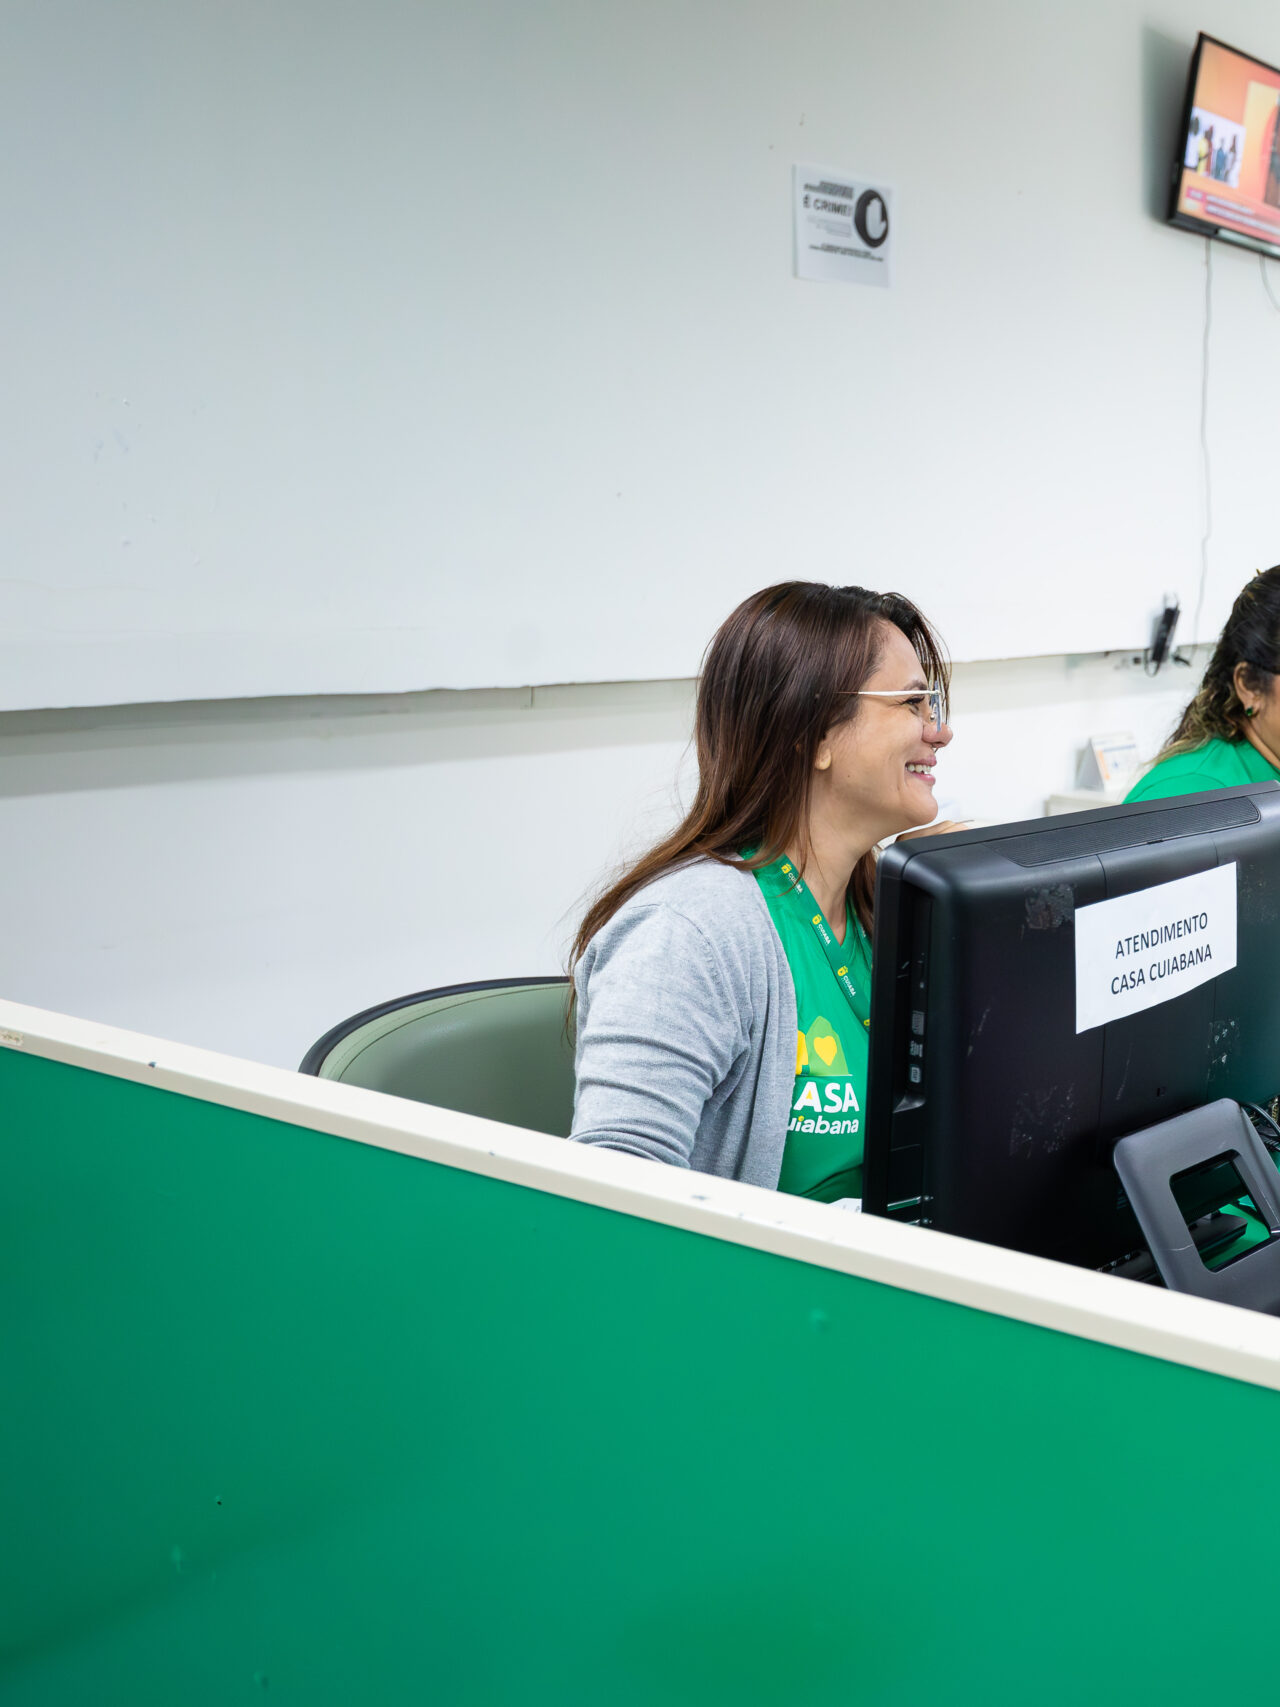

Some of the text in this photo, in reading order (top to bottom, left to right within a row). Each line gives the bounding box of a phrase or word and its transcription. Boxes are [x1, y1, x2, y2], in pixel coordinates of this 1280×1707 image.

[1115, 912, 1208, 960] ATENDIMENTO
[1111, 944, 1213, 996] CASA CUIABANA
[793, 1081, 860, 1113] ASA
[787, 1115, 860, 1135] uiabana
